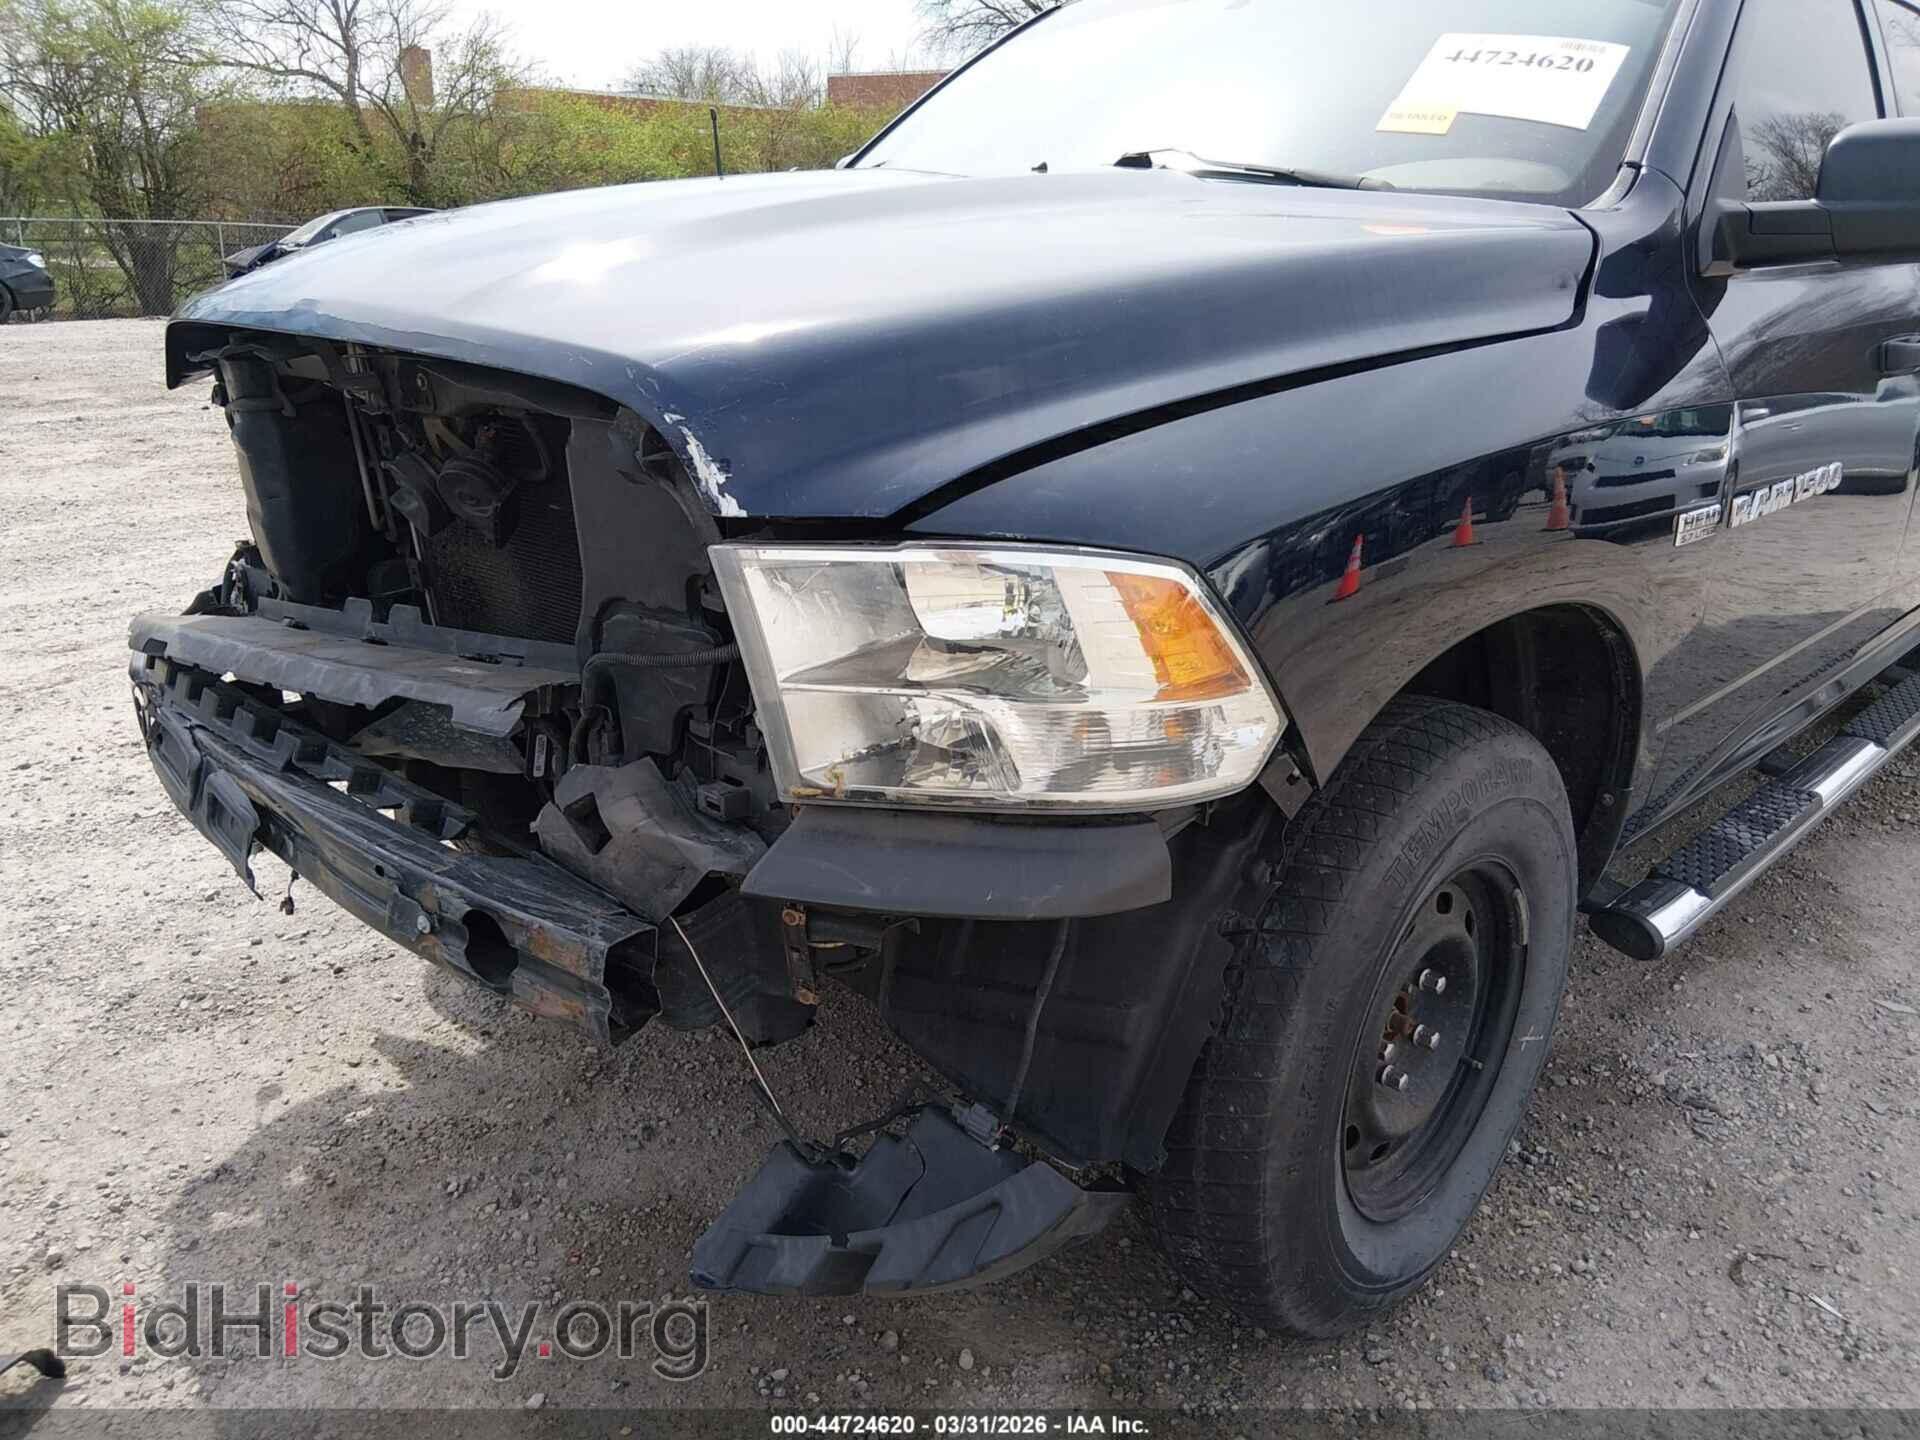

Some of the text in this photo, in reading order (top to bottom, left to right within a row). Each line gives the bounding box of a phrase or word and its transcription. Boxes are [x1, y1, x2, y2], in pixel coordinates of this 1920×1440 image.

[1444, 48, 1595, 73] 44724620
[1731, 462, 1843, 528] RAM 1500
[1383, 757, 1534, 889] TEMPORARY
